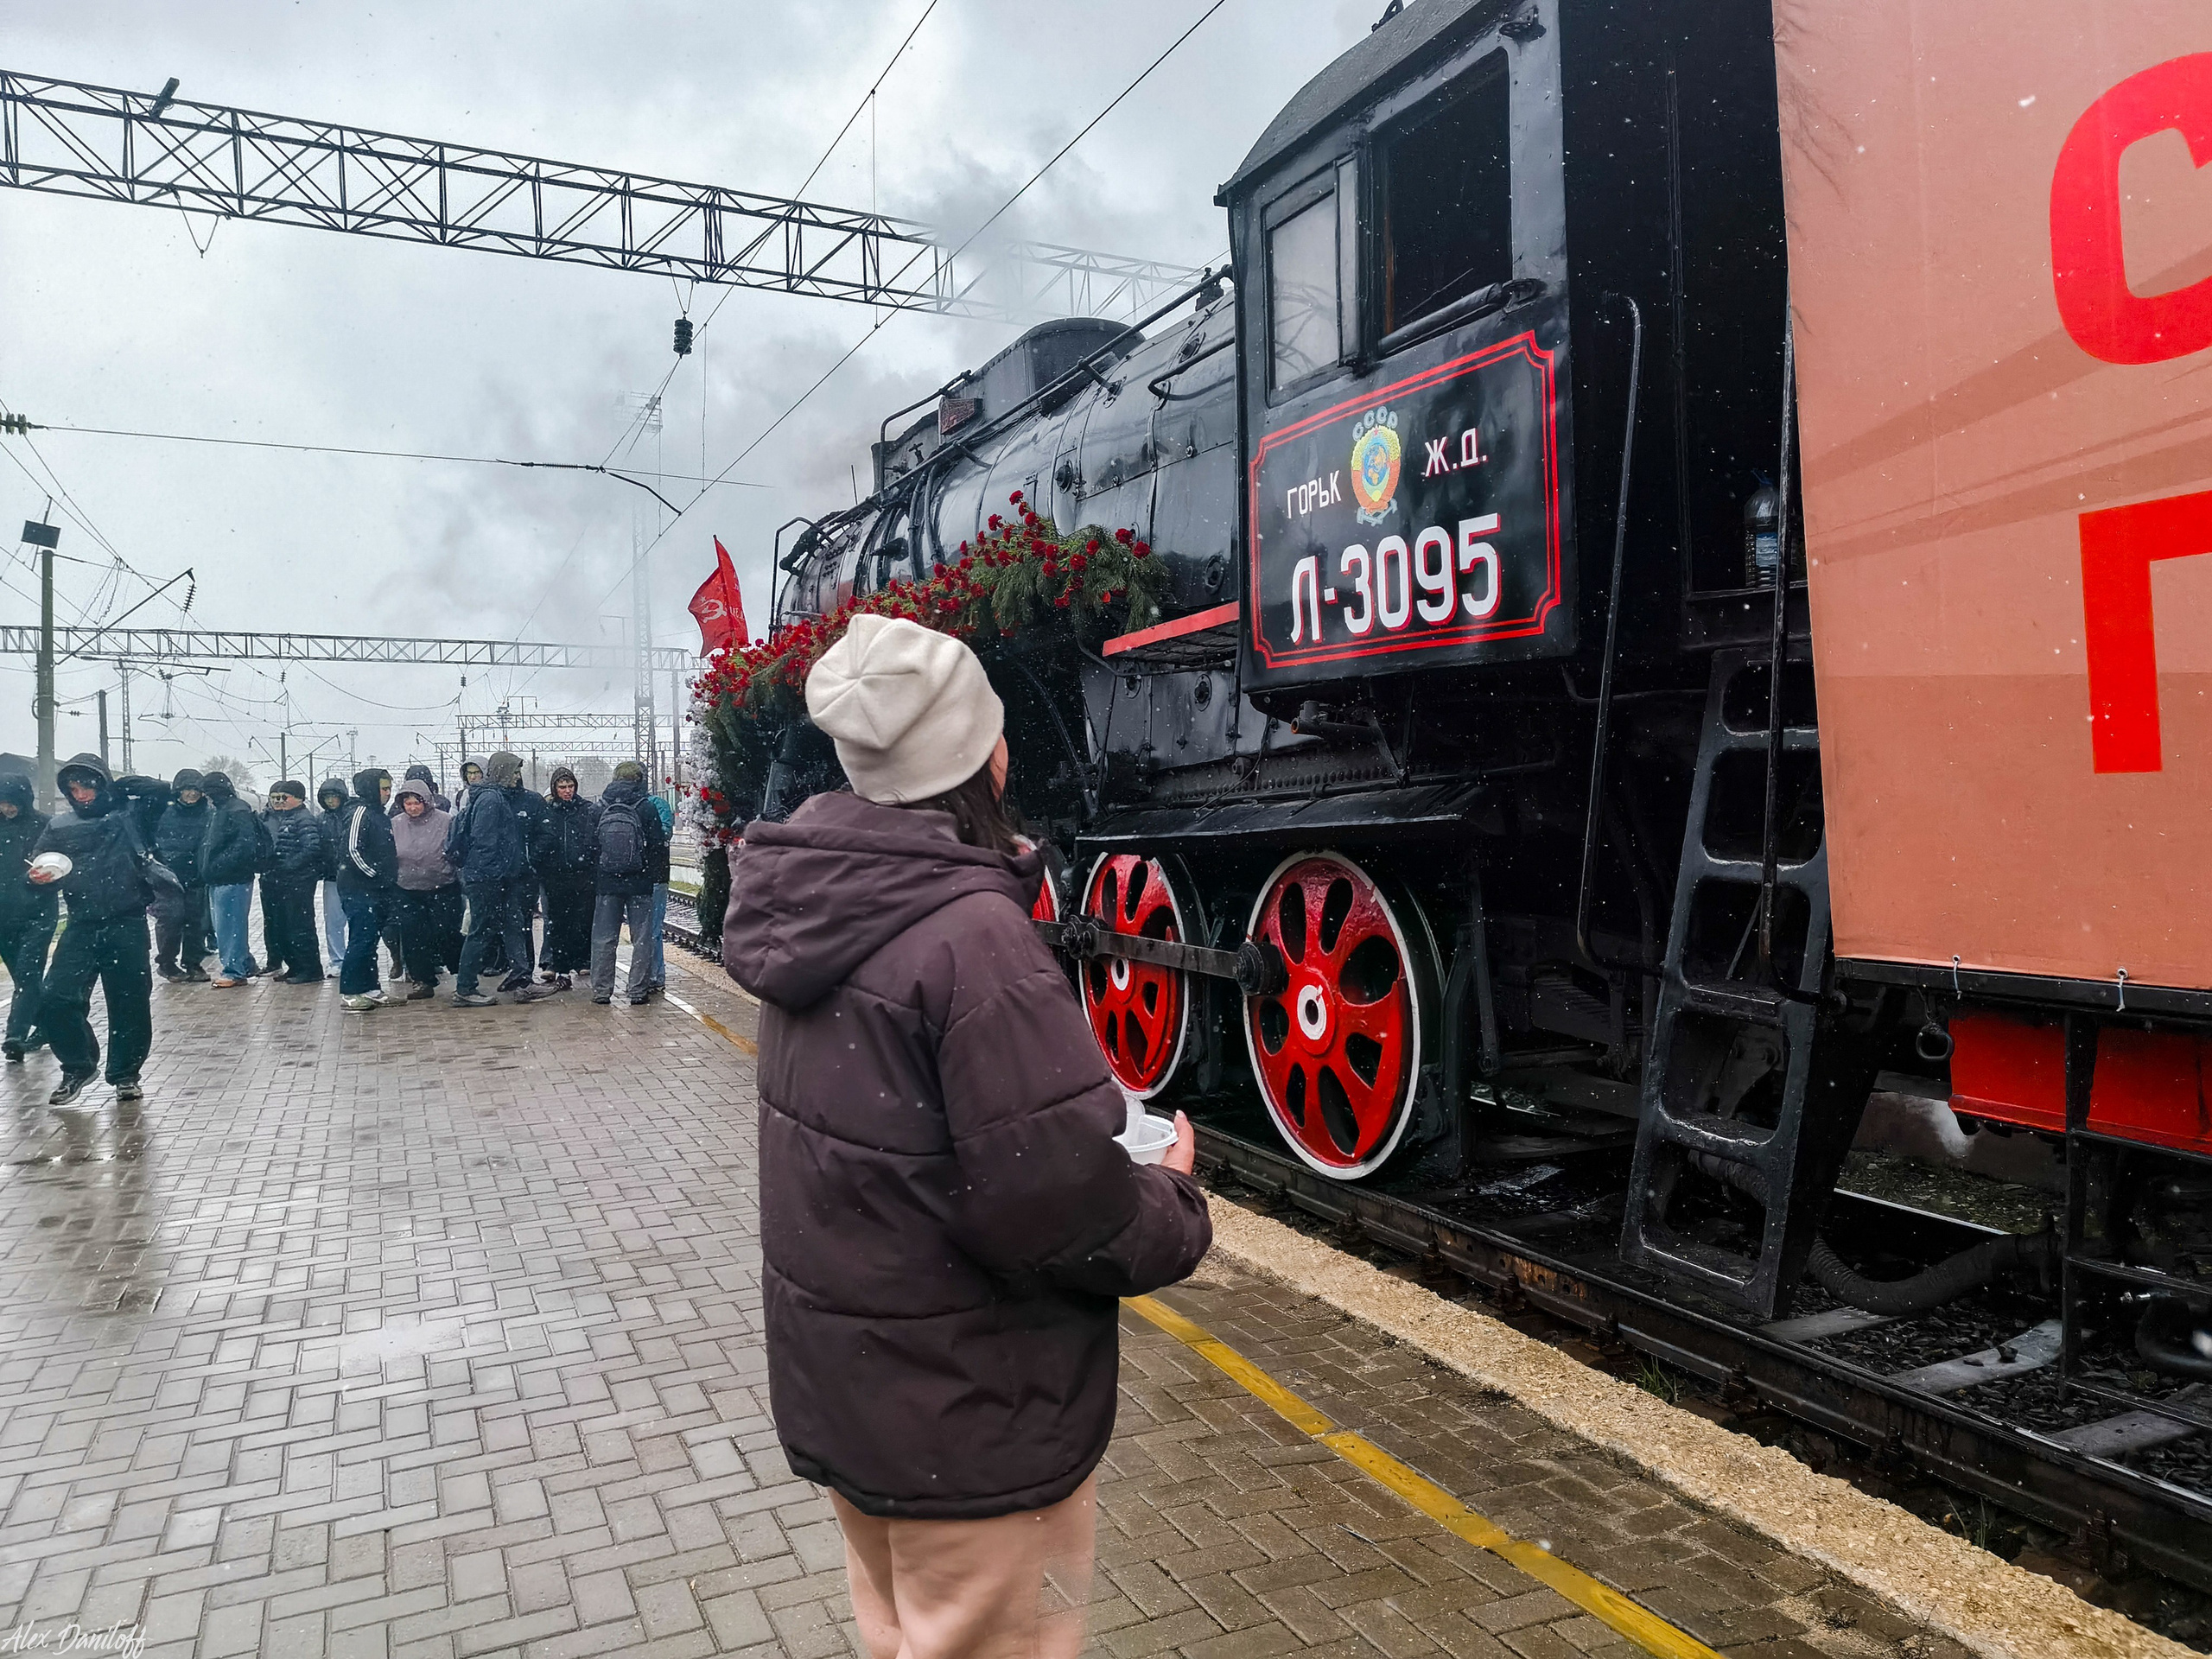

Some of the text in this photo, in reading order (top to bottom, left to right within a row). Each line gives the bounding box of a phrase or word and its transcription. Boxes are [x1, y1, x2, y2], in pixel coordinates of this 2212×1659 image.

[1287, 428, 1488, 518] ГОРЬК Ж.Д.
[1290, 513, 1500, 645] Л-3095
